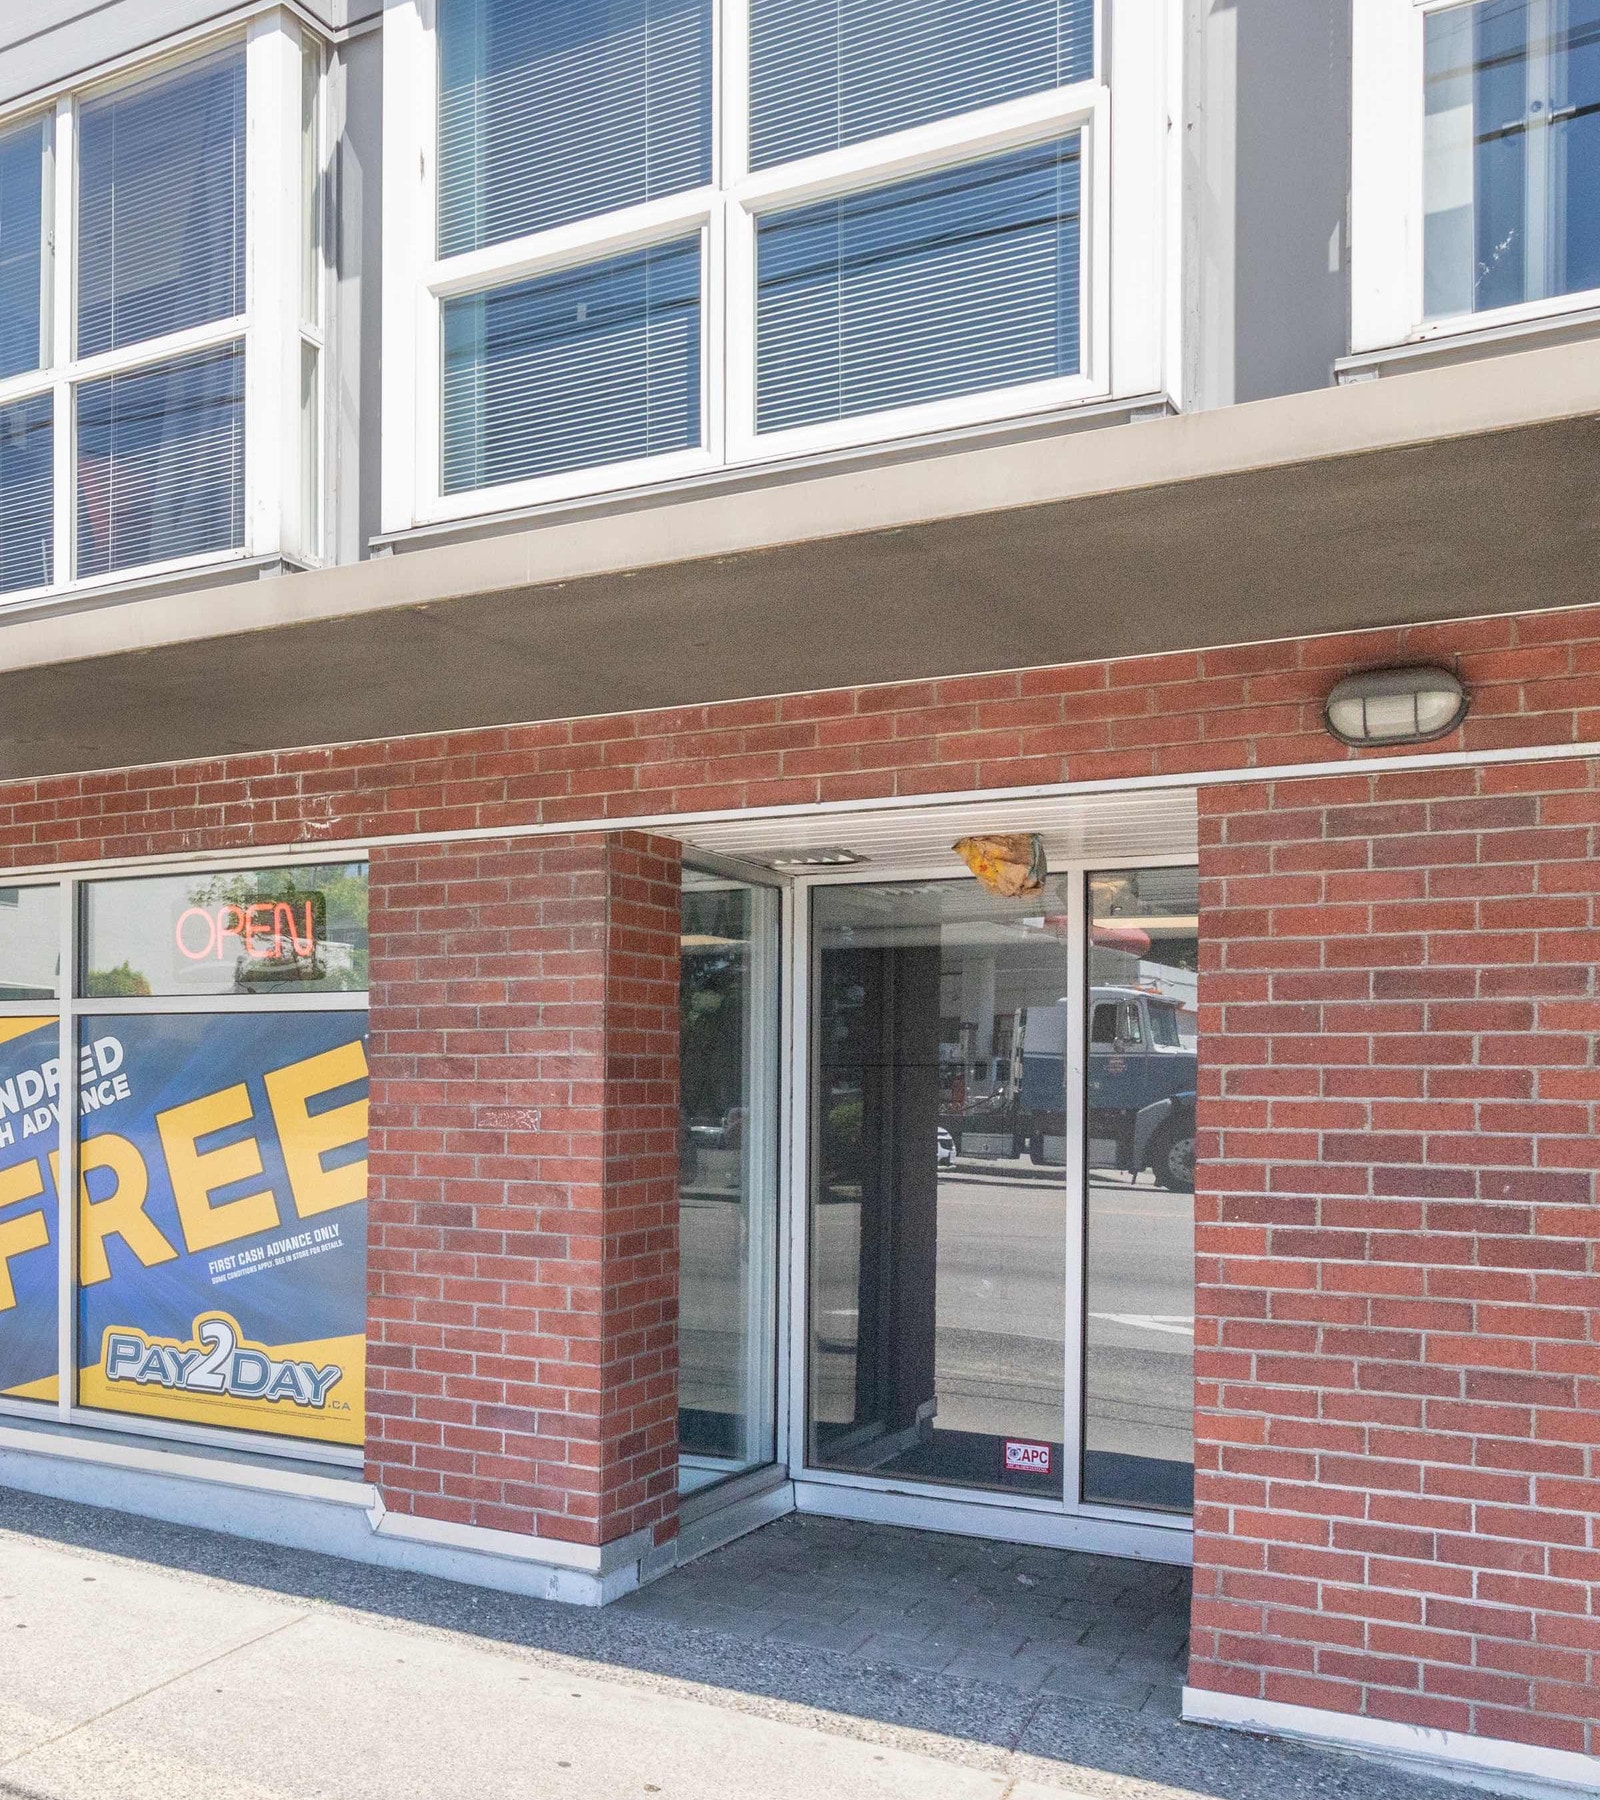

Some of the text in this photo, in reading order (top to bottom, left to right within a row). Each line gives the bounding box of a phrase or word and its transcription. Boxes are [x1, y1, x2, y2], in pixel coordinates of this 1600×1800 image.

[175, 900, 314, 961] OPEN
[22, 1073, 132, 1139] ADVNCE
[208, 1223, 340, 1275] FIRST CASH ADVANCE ONLY
[211, 1275, 228, 1285] SOME
[227, 1265, 258, 1280] CONDITIONS
[274, 1257, 286, 1267] SEE
[292, 1251, 310, 1261] STORE
[310, 1247, 321, 1256] FOR
[1021, 1449, 1048, 1464] APC
